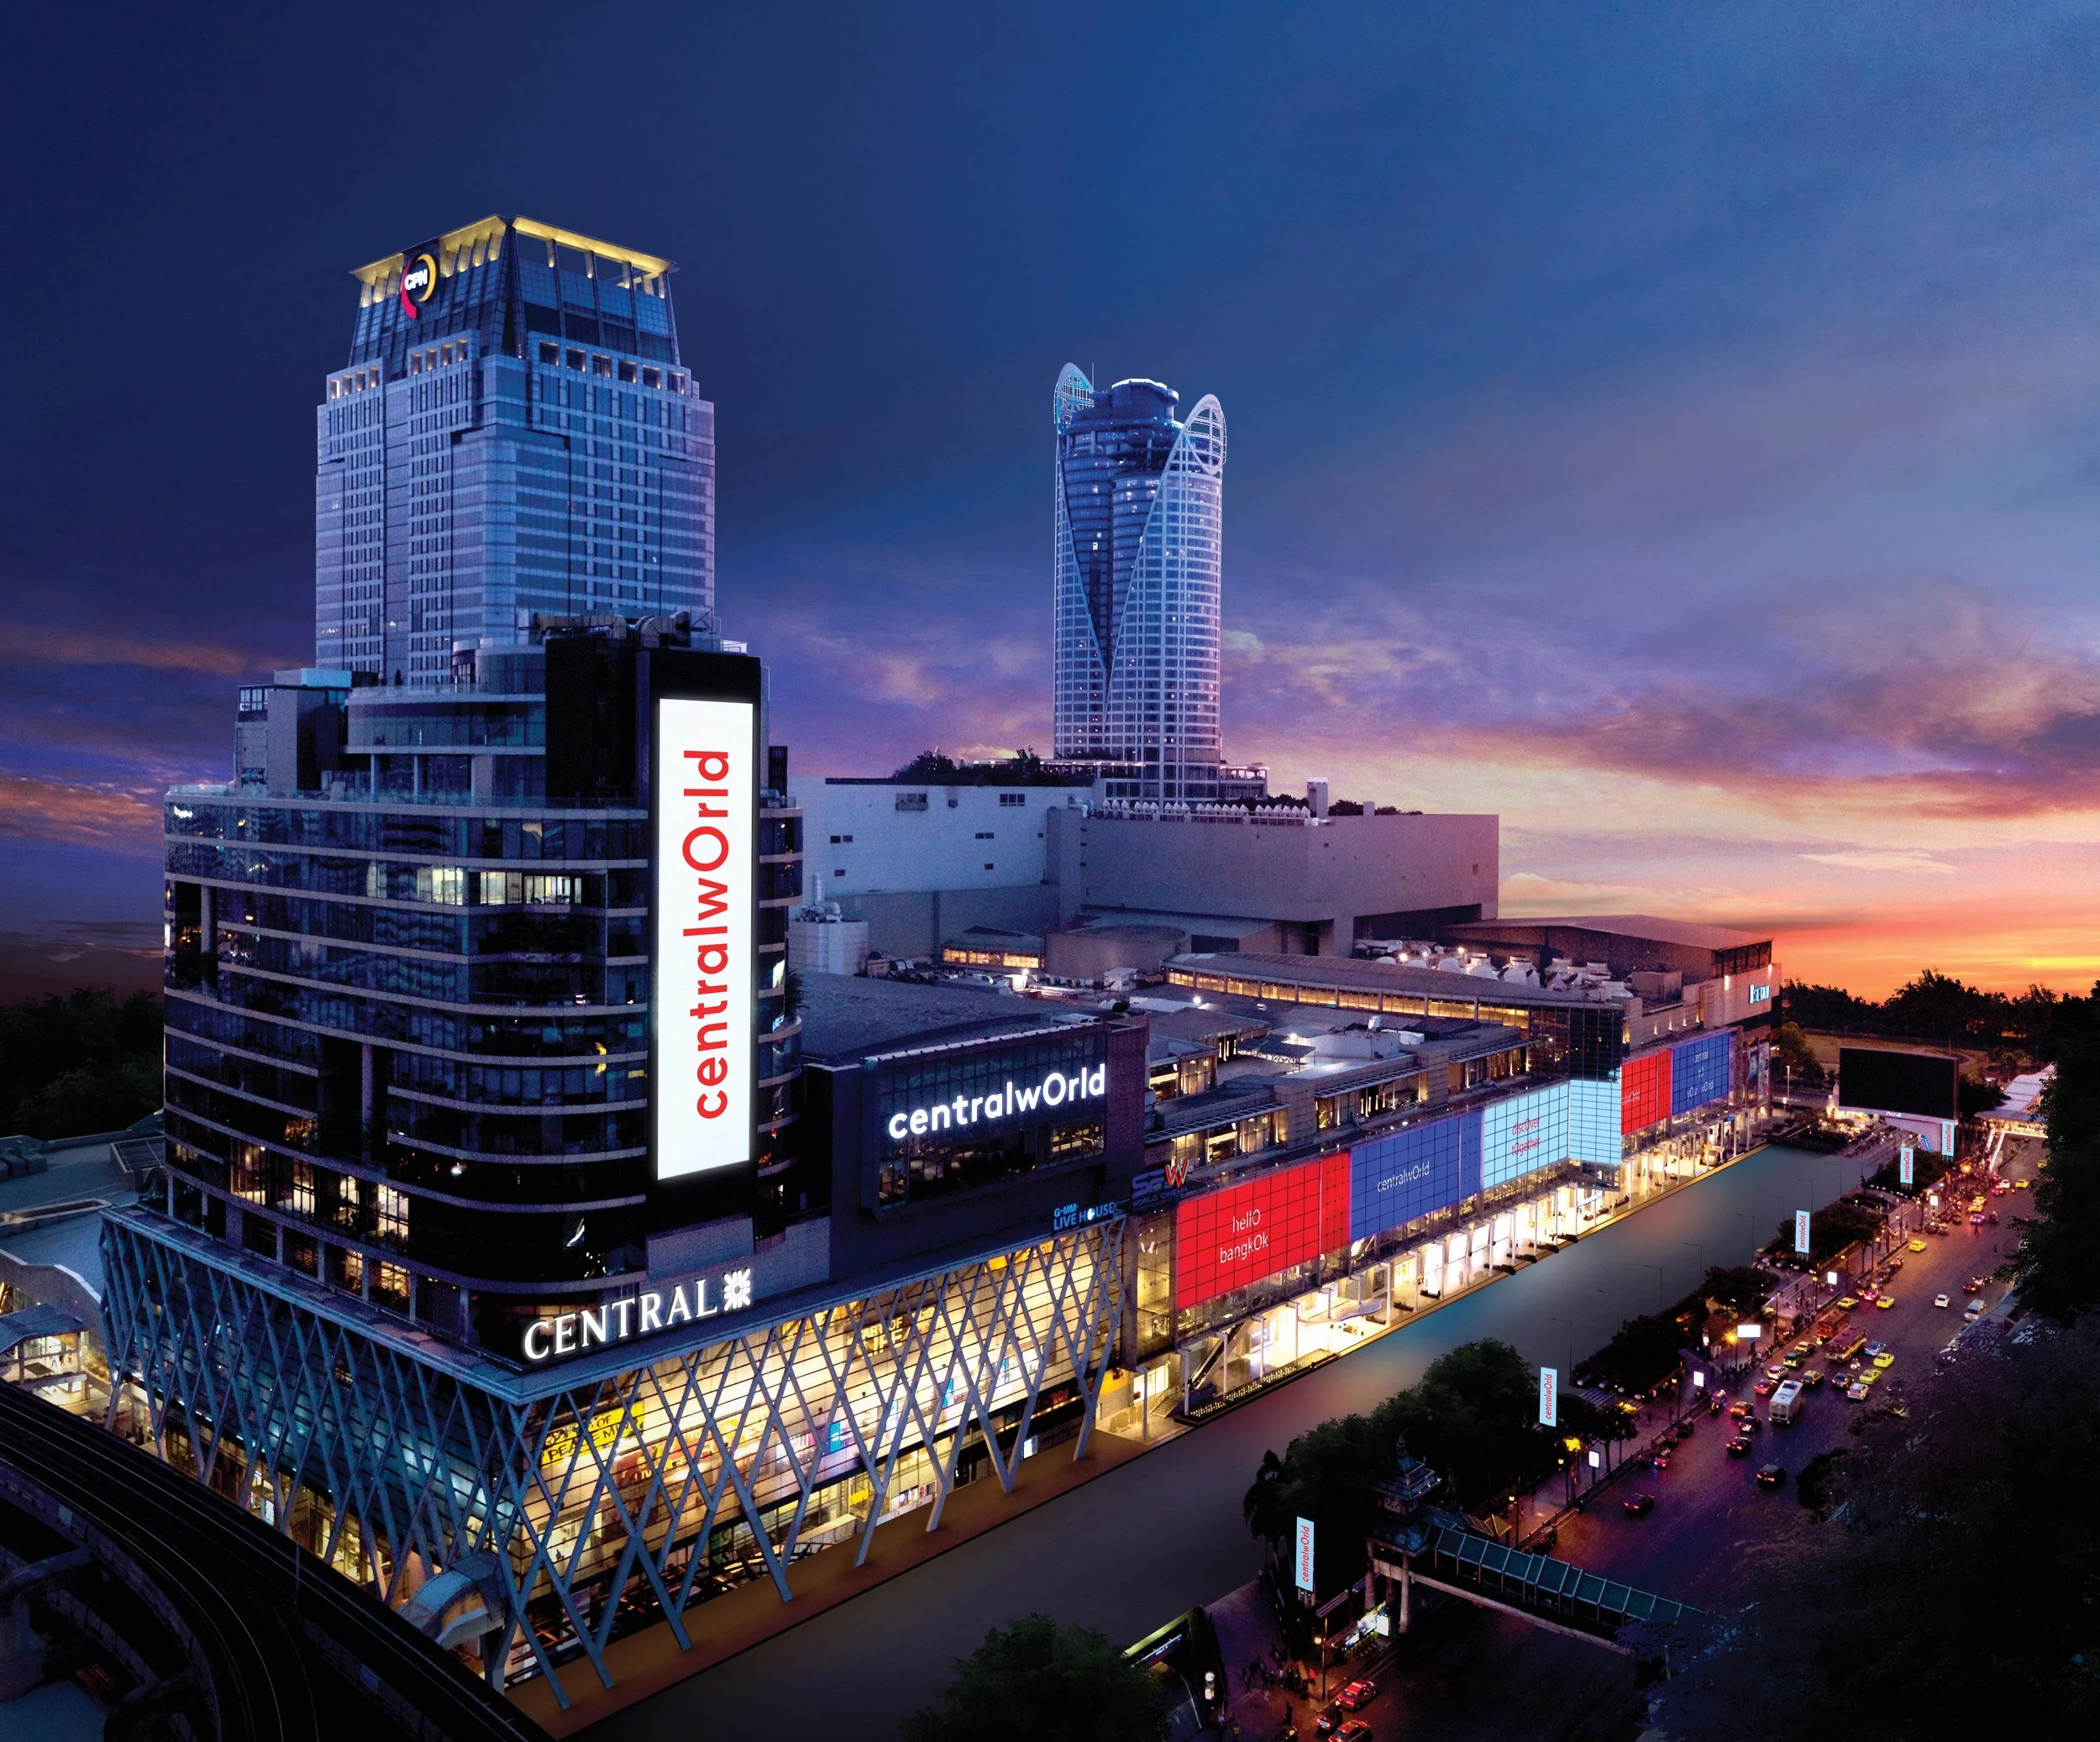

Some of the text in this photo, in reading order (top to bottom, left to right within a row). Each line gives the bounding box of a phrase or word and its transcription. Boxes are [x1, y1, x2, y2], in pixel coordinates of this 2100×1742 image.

[405, 269, 428, 290] CPN
[682, 750, 729, 1120] centralwOrld
[889, 1063, 1106, 1140] centralwOrld
[1053, 1212, 1077, 1230] LIVE
[523, 1278, 717, 1360] CENTRAL
[548, 1433, 600, 1461] PEAE
